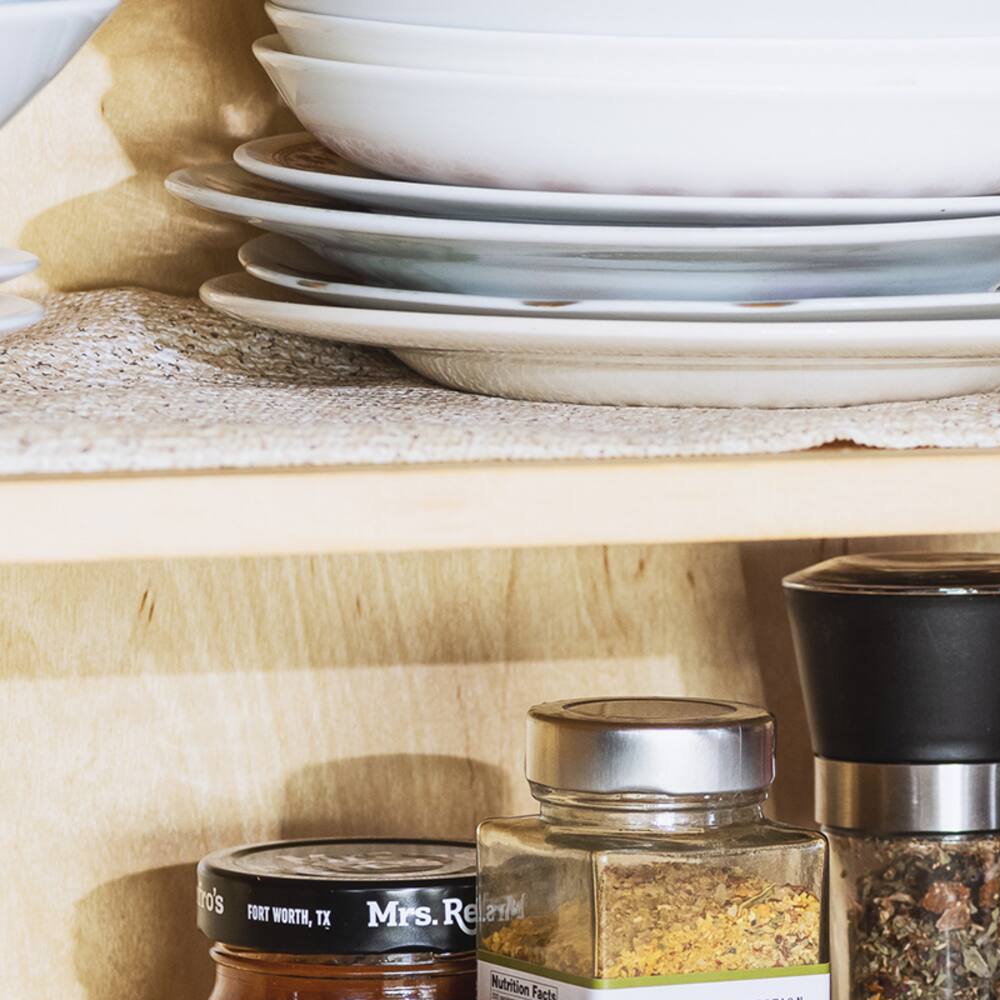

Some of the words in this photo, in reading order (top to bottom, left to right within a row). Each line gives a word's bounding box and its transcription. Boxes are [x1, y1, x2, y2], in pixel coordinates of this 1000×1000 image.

[197, 882, 224, 915] ro's
[247, 904, 270, 922] FORT
[272, 906, 313, 928] WORTH,
[315, 909, 331, 926] TX
[367, 900, 438, 928] Mrs.
[491, 974, 530, 997] Nutrition
